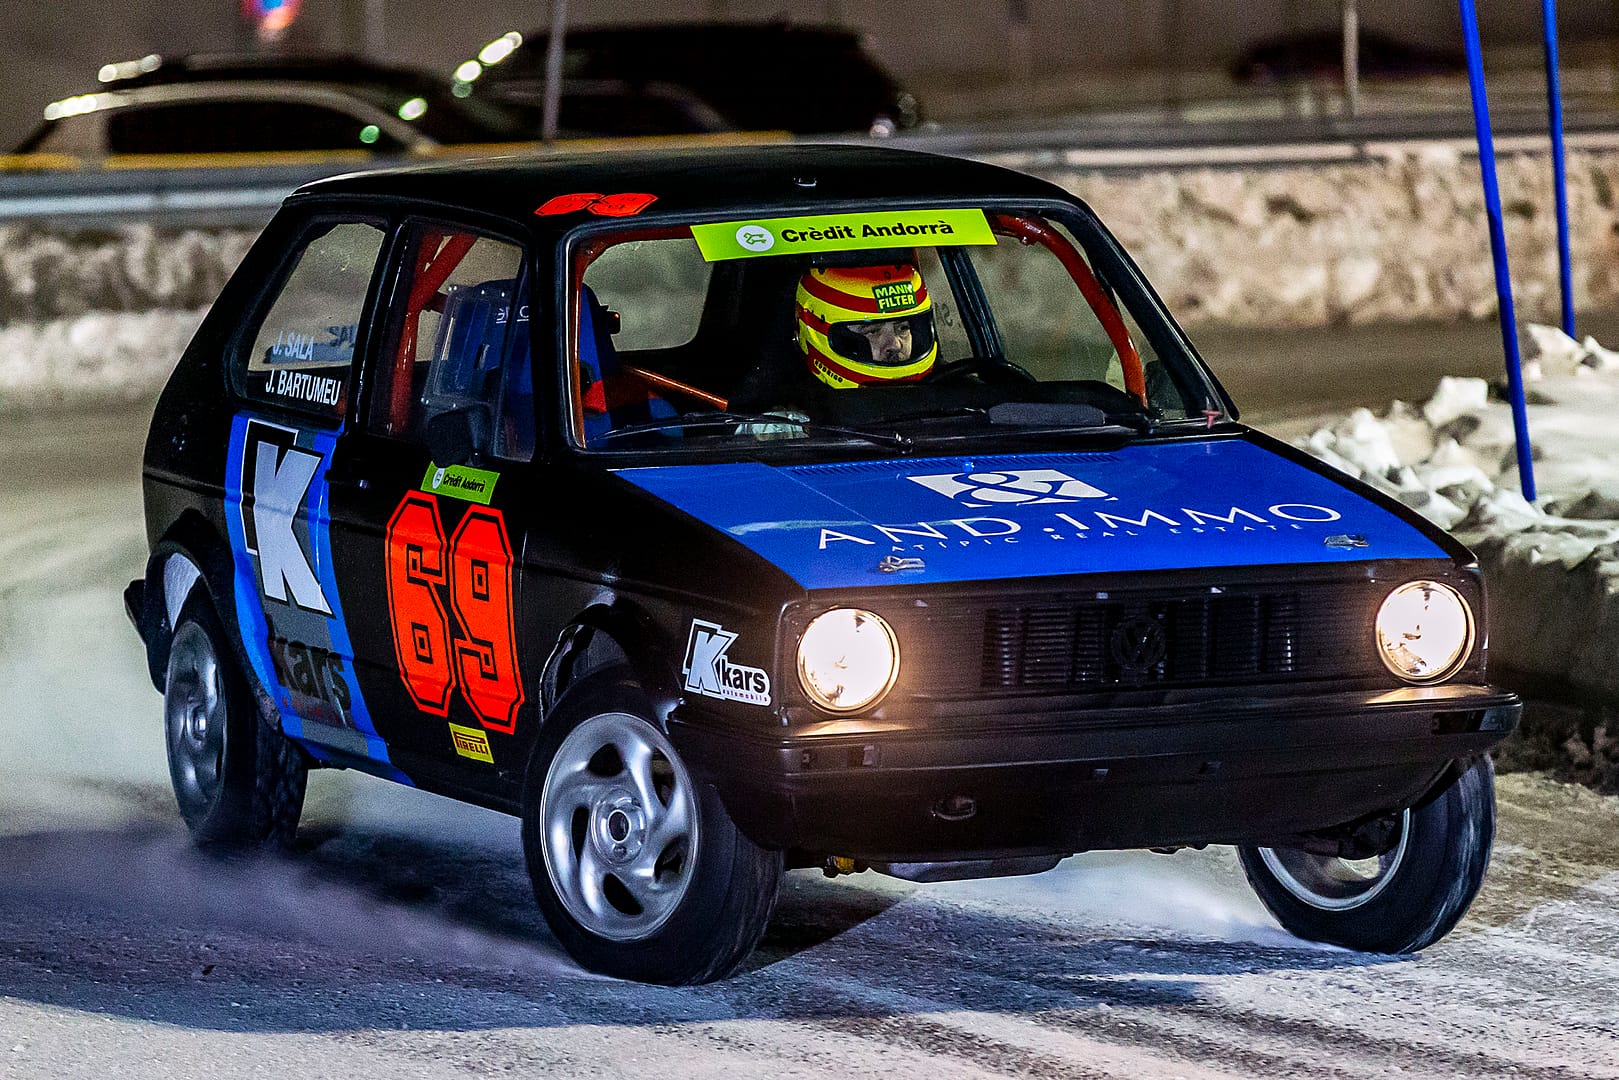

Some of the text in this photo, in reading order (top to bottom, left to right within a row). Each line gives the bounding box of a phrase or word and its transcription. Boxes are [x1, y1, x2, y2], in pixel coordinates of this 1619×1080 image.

[781, 220, 954, 243] Crèdit Andorrà
[875, 284, 913, 298] MANN
[878, 294, 915, 309] FILTER
[272, 330, 314, 361] J. SALA
[265, 368, 342, 406] J. BARTUMEU
[891, 524, 1303, 552] ATIPIC REAL ESTATE
[384, 489, 525, 735] 69
[720, 658, 766, 694] kars
[452, 731, 489, 755] PIRELLI
